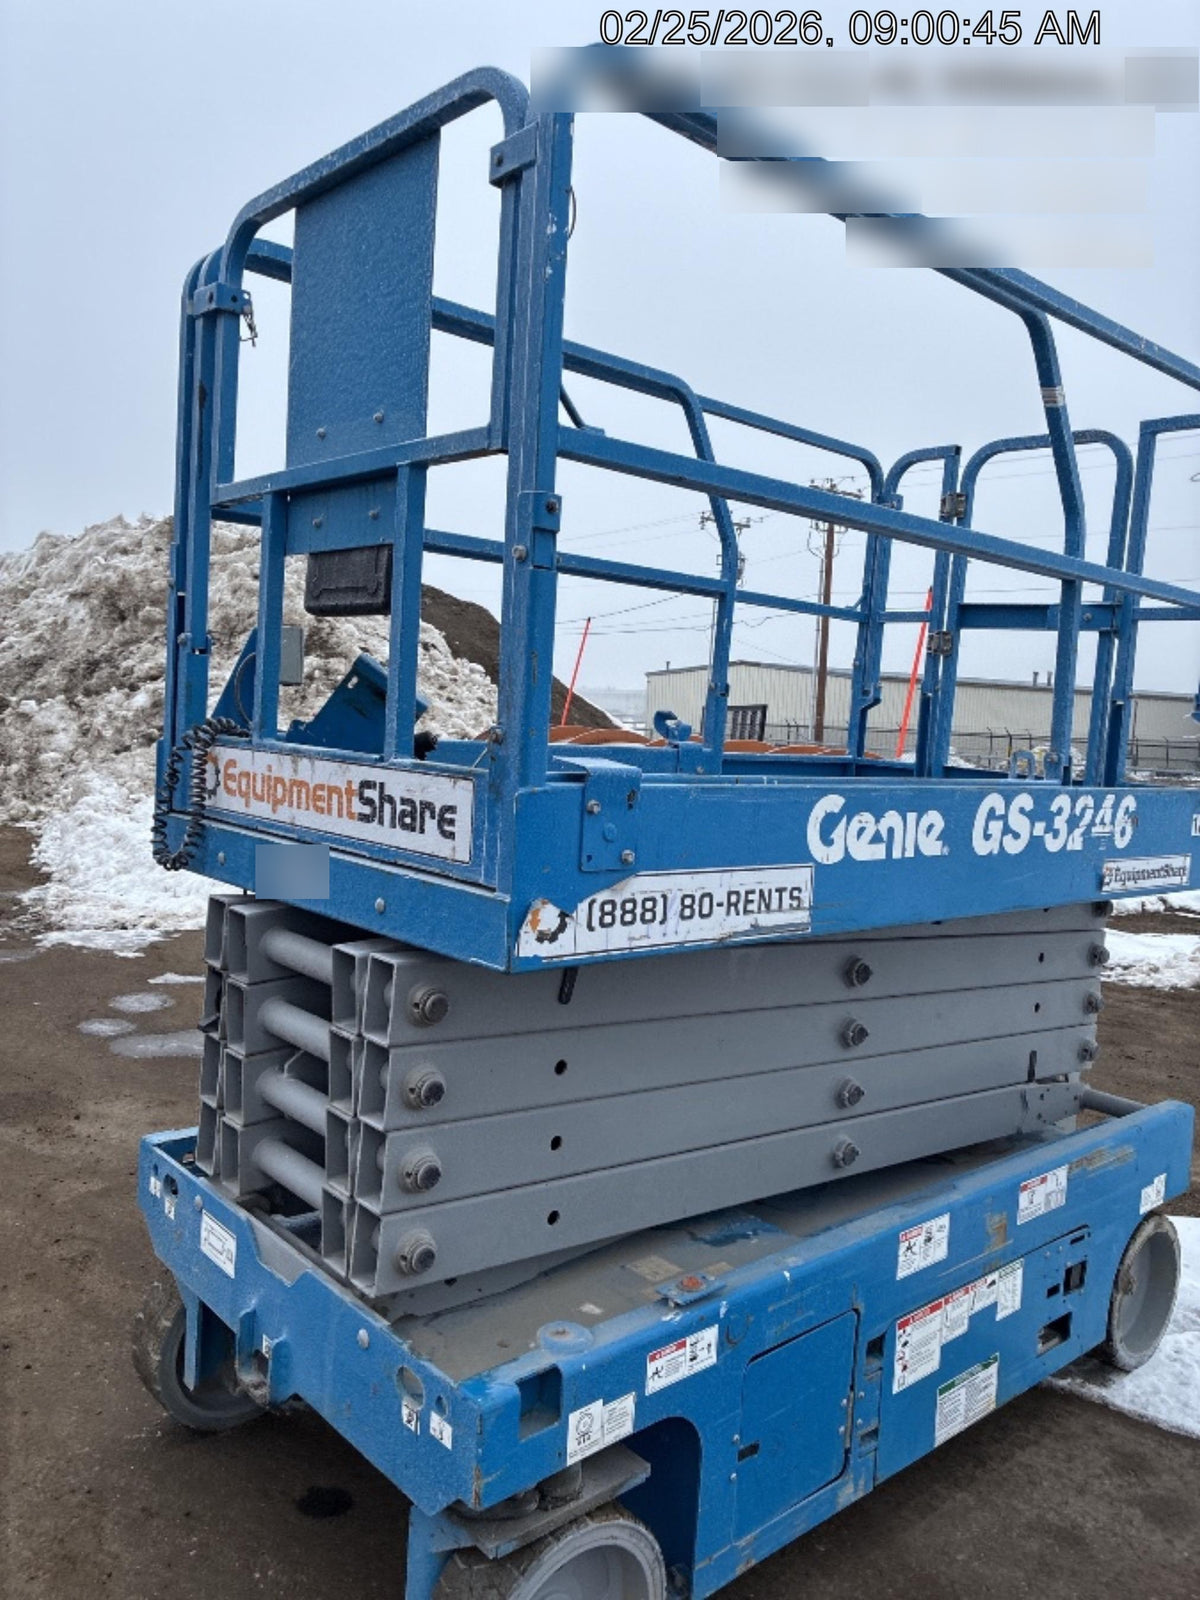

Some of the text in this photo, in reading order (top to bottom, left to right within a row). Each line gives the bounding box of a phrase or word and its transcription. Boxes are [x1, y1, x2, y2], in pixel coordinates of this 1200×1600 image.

[222, 758, 457, 840] EquipmentShare
[972, 792, 1137, 857] GS-3246
[586, 887, 803, 932] (888) 80-RENTS
